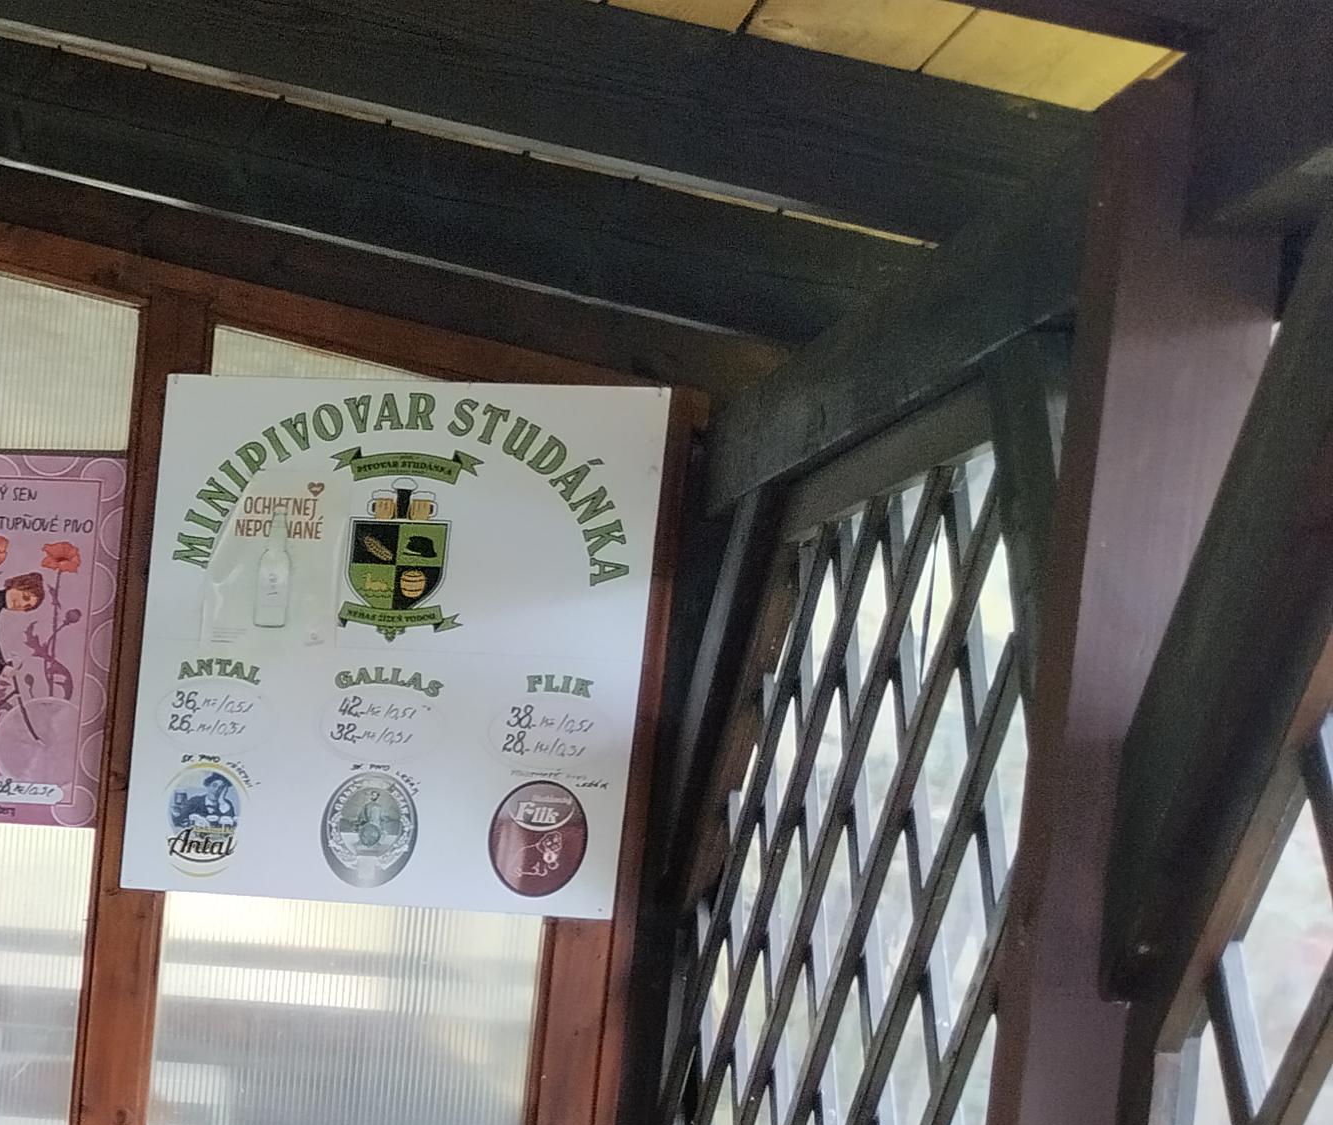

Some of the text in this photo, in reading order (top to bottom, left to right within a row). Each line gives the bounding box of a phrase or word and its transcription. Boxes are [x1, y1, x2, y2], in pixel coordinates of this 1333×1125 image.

[13, 486, 37, 501] SEN
[172, 392, 630, 587] MINIPIVOVAR STUDÁNKA
[63, 518, 94, 533] PIVO
[177, 658, 261, 685] ANTAL
[335, 667, 444, 697] GALLAS
[526, 674, 594, 698] FLIK
[514, 801, 559, 824] Flik
[167, 827, 237, 857] Antal
